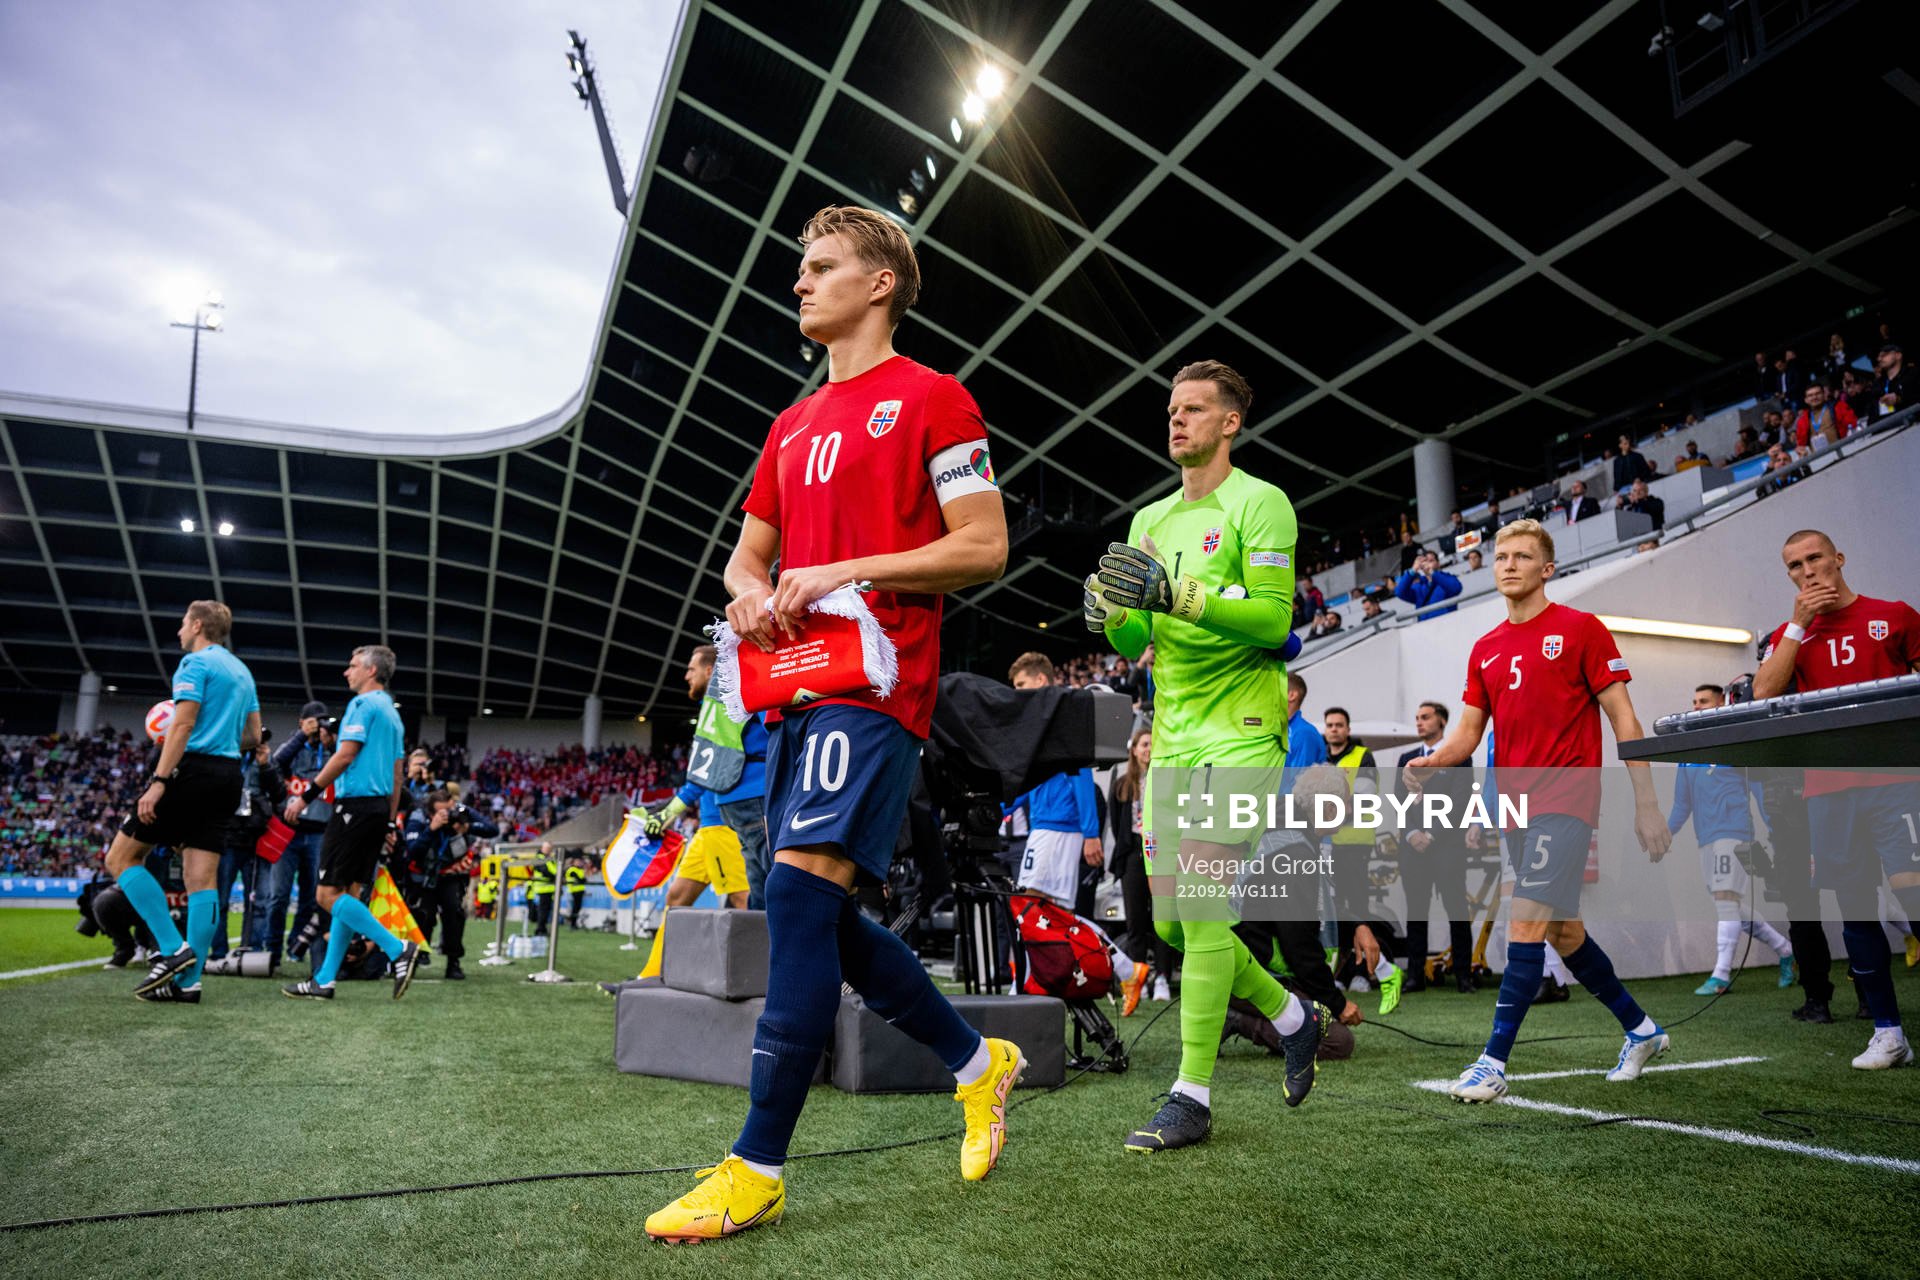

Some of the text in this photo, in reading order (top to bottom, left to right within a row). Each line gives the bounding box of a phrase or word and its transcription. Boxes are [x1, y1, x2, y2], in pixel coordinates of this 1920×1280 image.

[804, 431, 842, 486] 10
[935, 464, 973, 488] #ONE
[1174, 551, 1183, 580] 1
[770, 660, 797, 671] NORWAY
[800, 652, 830, 665] SLOVENIA
[1826, 635, 1856, 667] 15
[1509, 655, 1522, 690] 5
[687, 740, 714, 780] 12
[803, 730, 850, 792] 10
[1024, 848, 1034, 870] 6
[1530, 834, 1552, 870] 5
[1714, 854, 1731, 875] 18
